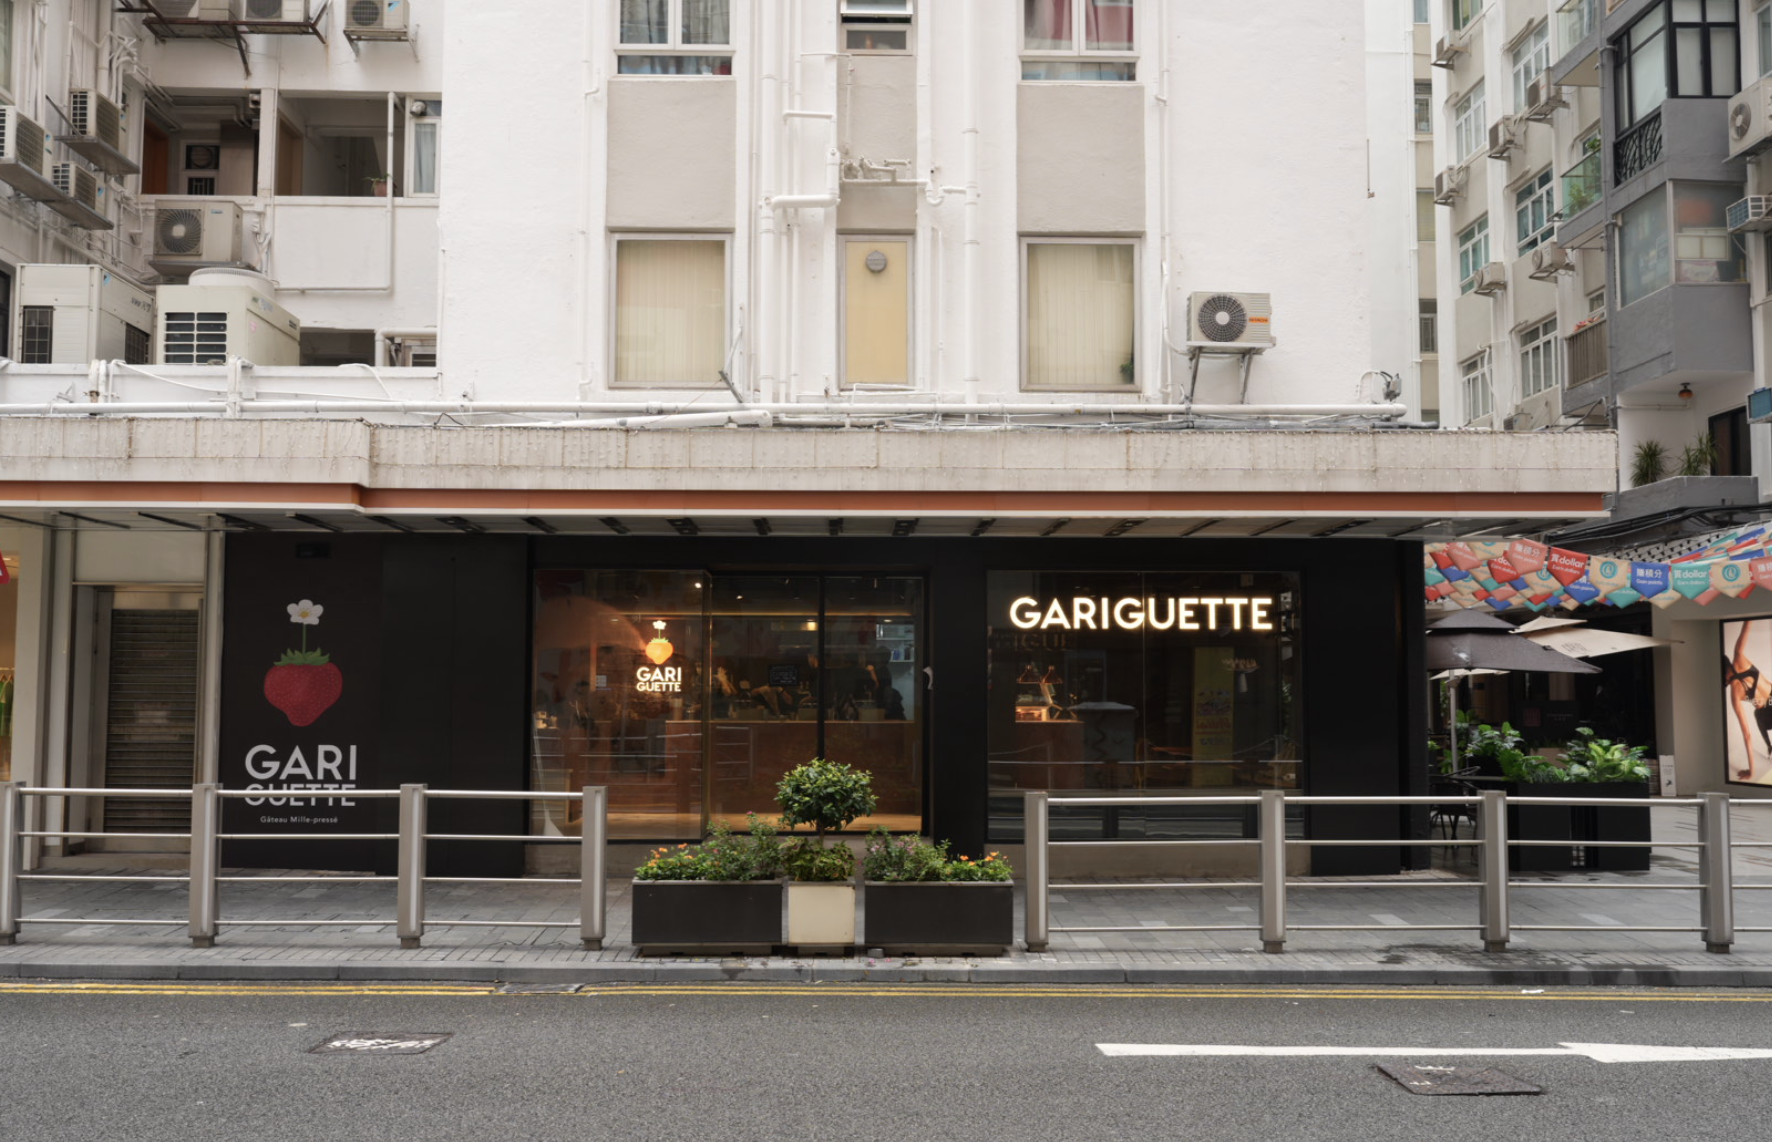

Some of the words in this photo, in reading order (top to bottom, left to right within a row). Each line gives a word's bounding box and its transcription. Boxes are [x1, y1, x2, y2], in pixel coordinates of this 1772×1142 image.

[1009, 597, 1273, 630] GARIGUETTE
[636, 666, 682, 682] GARI
[636, 682, 681, 692] GUETTE
[245, 744, 357, 780] GARI
[260, 815, 288, 823] Gâteau
[290, 815, 338, 825] Mille-pressé
